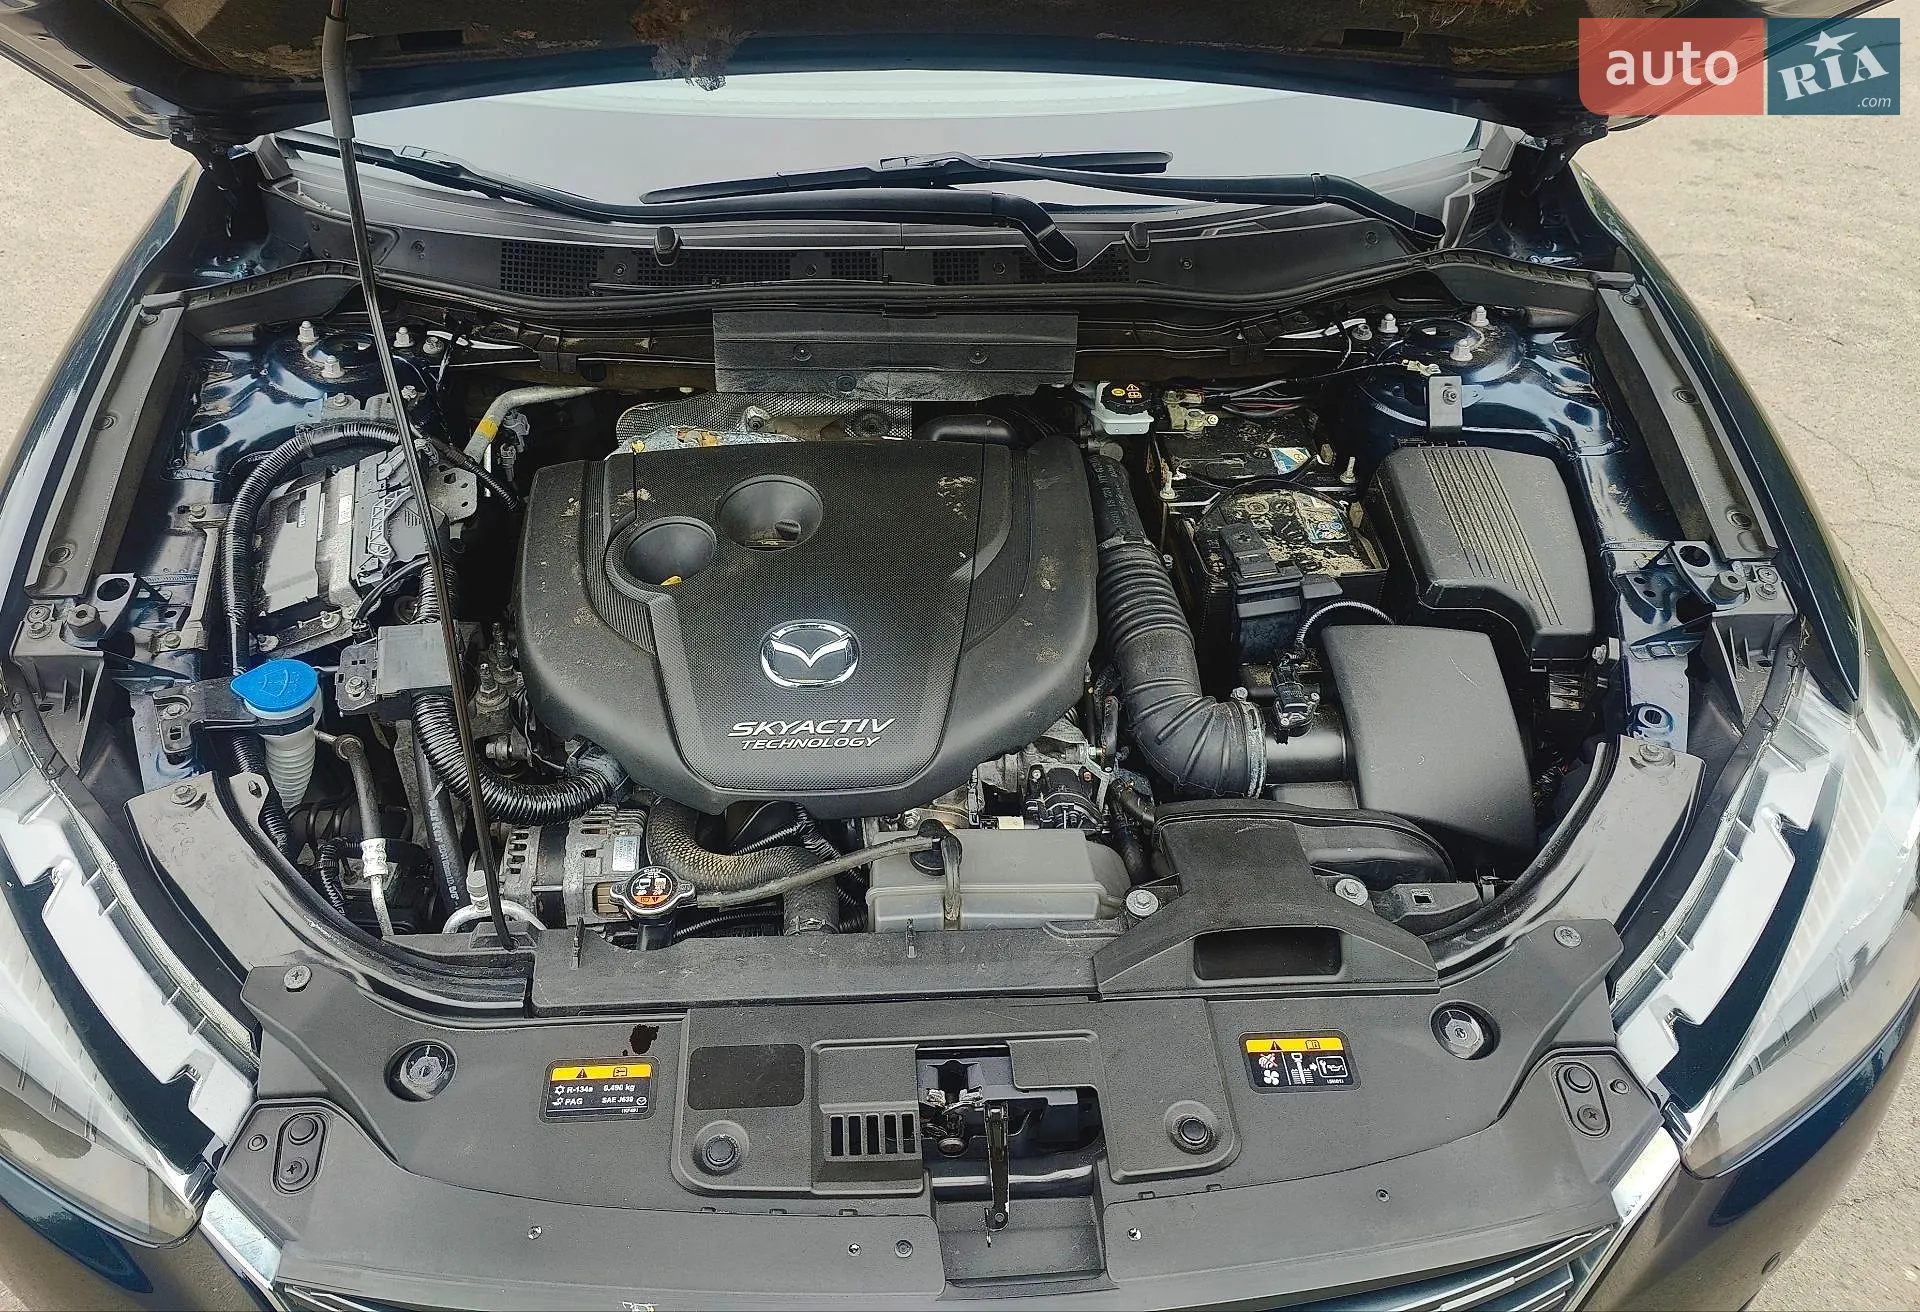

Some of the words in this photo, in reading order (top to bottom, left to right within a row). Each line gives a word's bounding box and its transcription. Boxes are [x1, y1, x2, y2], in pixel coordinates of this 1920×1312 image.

[727, 718, 896, 737] SKYACTIV
[741, 736, 881, 750] TECHNOLOGY
[625, 1083, 636, 1092] kg
[564, 1097, 583, 1106] PAG
[601, 1096, 617, 1104] SAE
